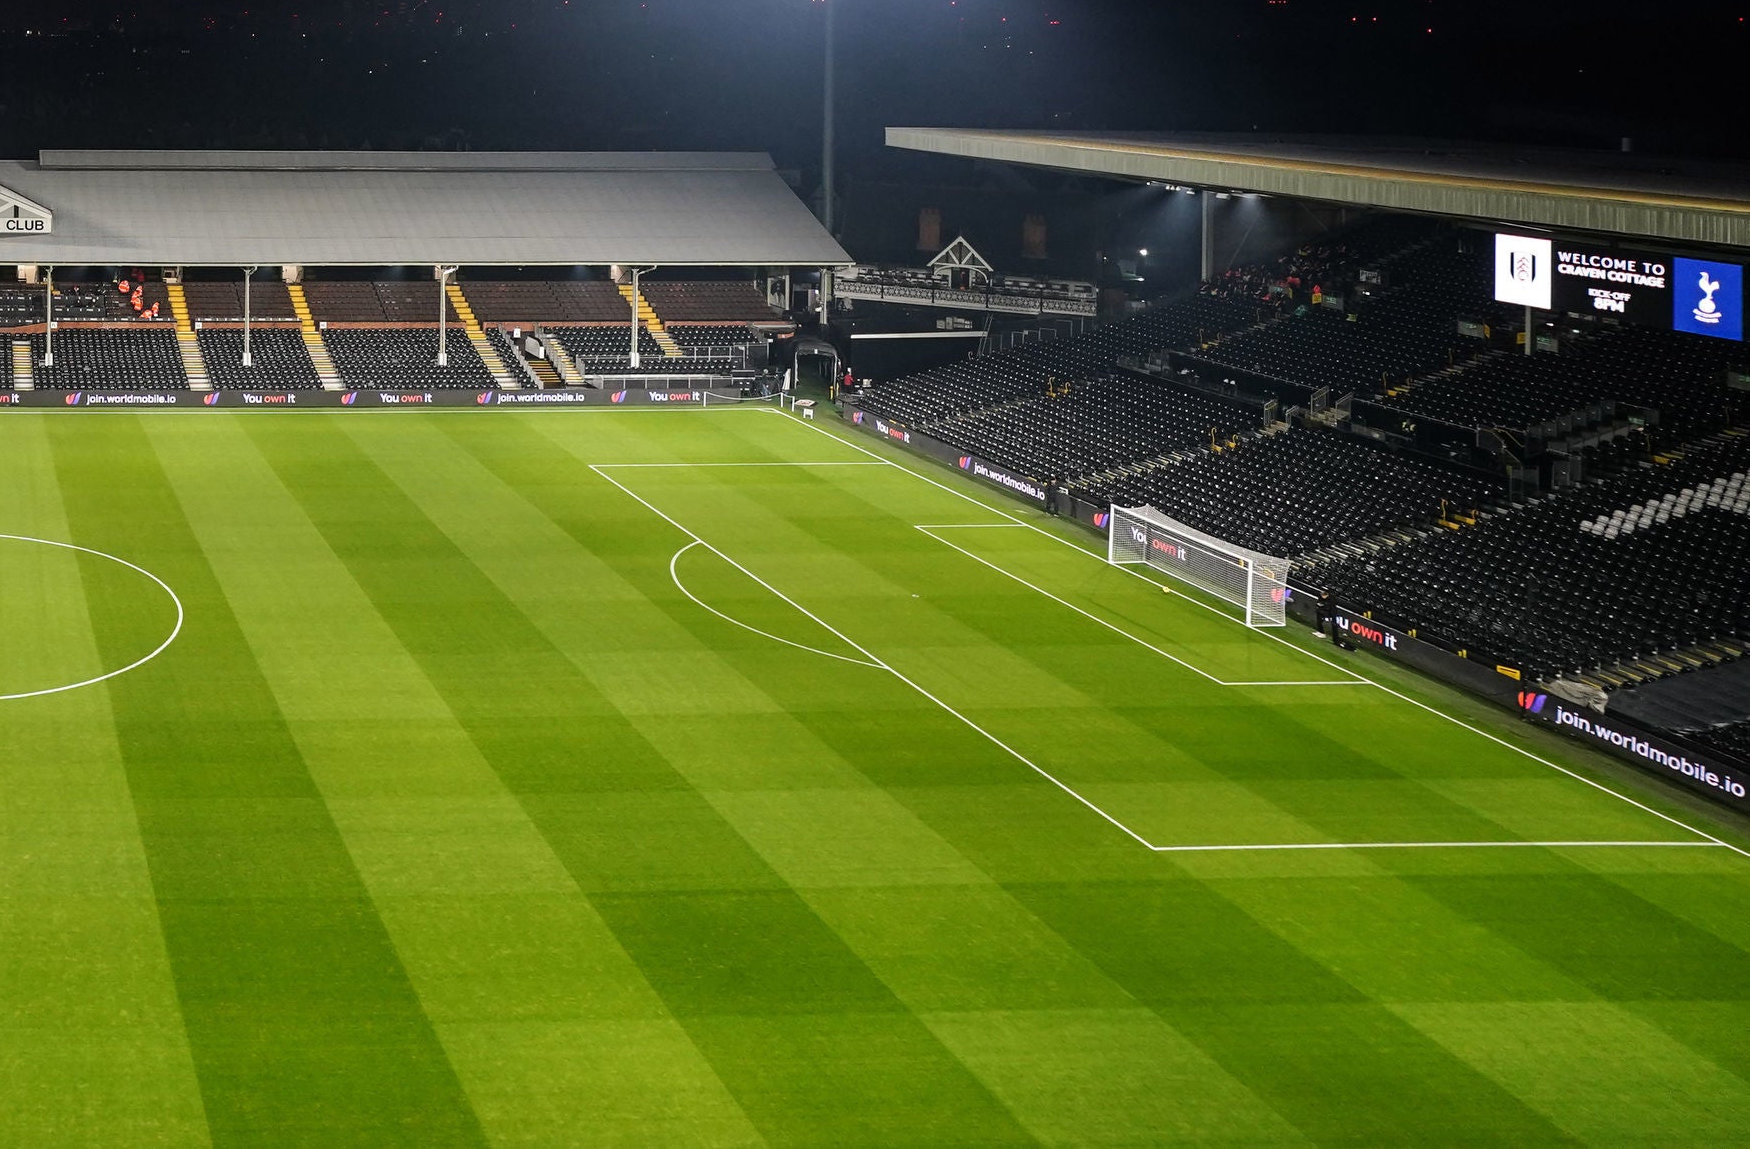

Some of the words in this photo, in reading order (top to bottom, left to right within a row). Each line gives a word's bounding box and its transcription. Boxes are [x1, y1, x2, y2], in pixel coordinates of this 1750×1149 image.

[6, 219, 45, 231] CLUB
[1557, 251, 1637, 272] WELCOME
[1643, 262, 1666, 276] TO
[1557, 264, 1607, 280] CRAVEN
[1607, 269, 1666, 289] COTTAGE
[1594, 298, 1625, 313] 8PM
[12, 394, 19, 403] it
[86, 394, 176, 405] join.worldmobile.io
[242, 394, 262, 403] You
[264, 395, 286, 403] own
[288, 394, 295, 403] it
[379, 393, 399, 403] You
[401, 395, 423, 403] own
[425, 393, 432, 402] it
[496, 393, 584, 404] join.worldmobile.io
[648, 392, 668, 401] You
[670, 393, 691, 401] own
[692, 391, 700, 401] it
[875, 420, 889, 435] You
[889, 428, 903, 440] own
[903, 431, 910, 443] it
[974, 462, 1045, 501] join.worldmobile.io
[1152, 539, 1177, 557] own
[1177, 546, 1186, 561] it
[1351, 621, 1383, 645] own
[1384, 632, 1397, 651] it
[1555, 704, 1746, 798] join.worldmobile.io
